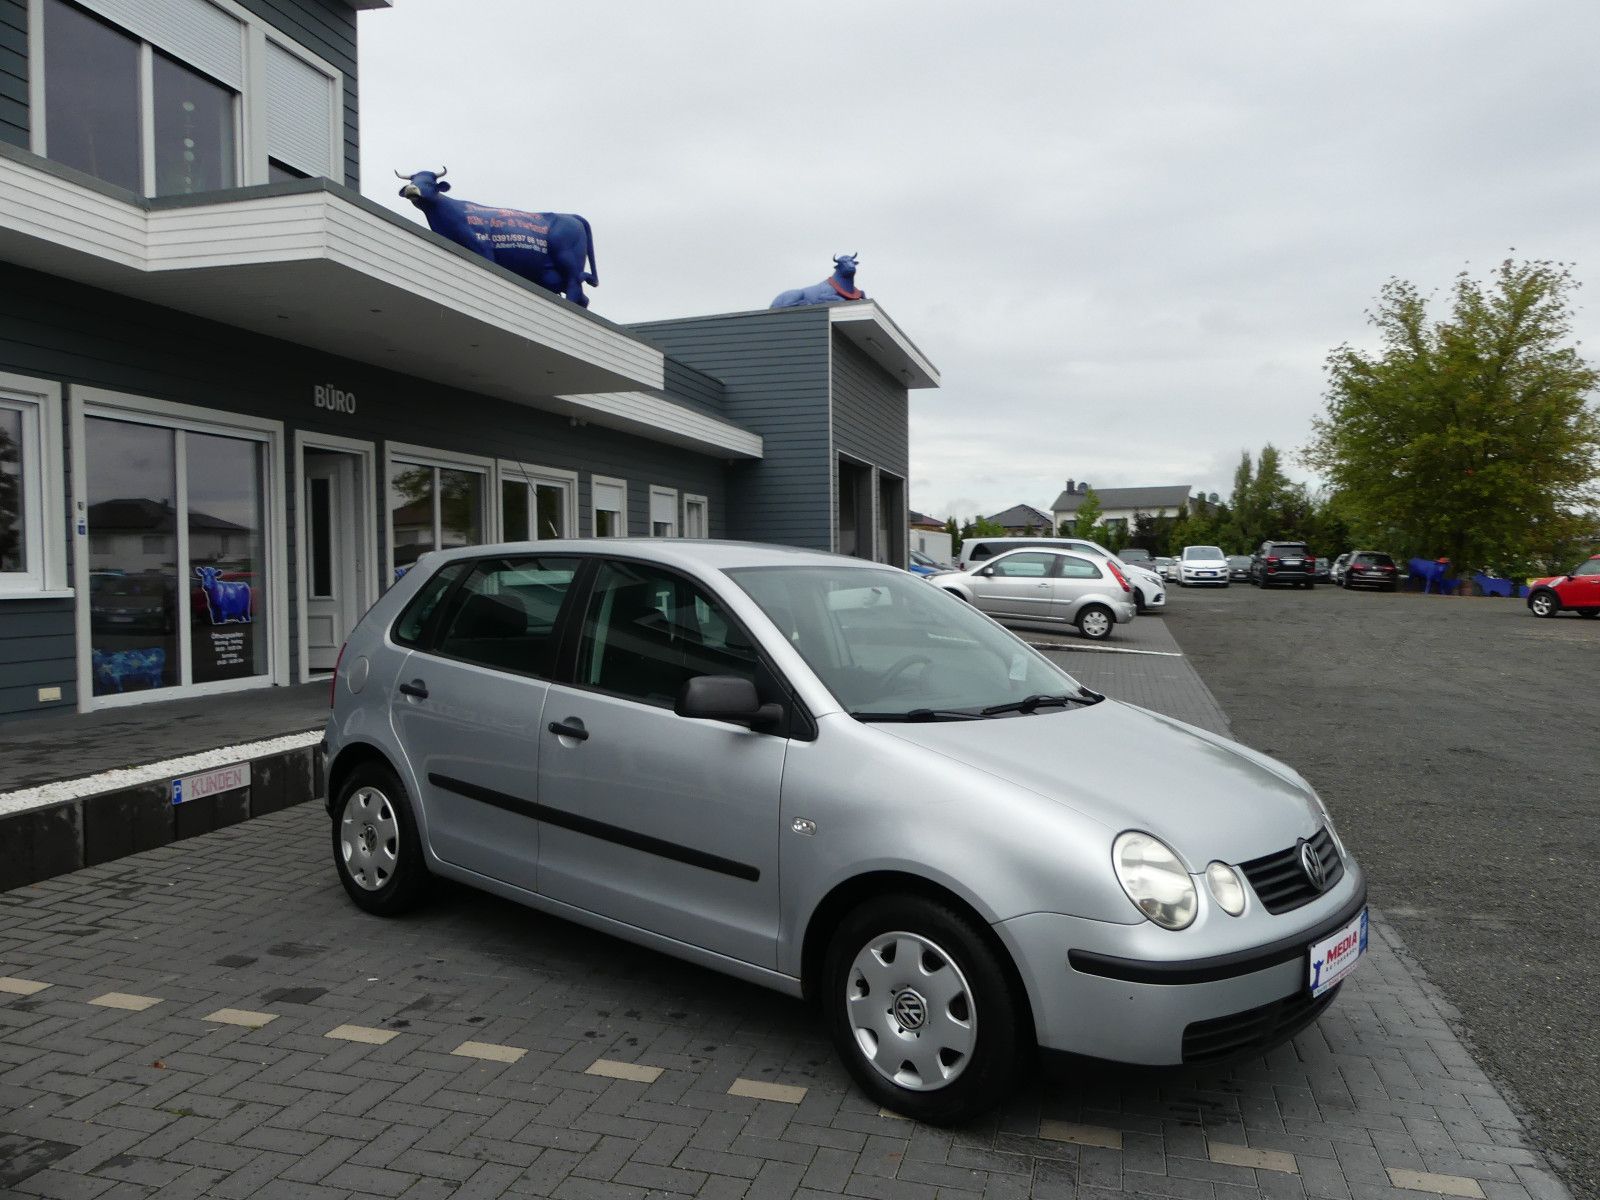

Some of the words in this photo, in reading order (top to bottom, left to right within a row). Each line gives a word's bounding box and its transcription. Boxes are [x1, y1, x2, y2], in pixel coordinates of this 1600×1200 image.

[475, 232, 491, 241] Tel.
[314, 384, 356, 414] BÜRO
[191, 769, 242, 797] KUNDEN
[1327, 930, 1358, 964] MEDIA
